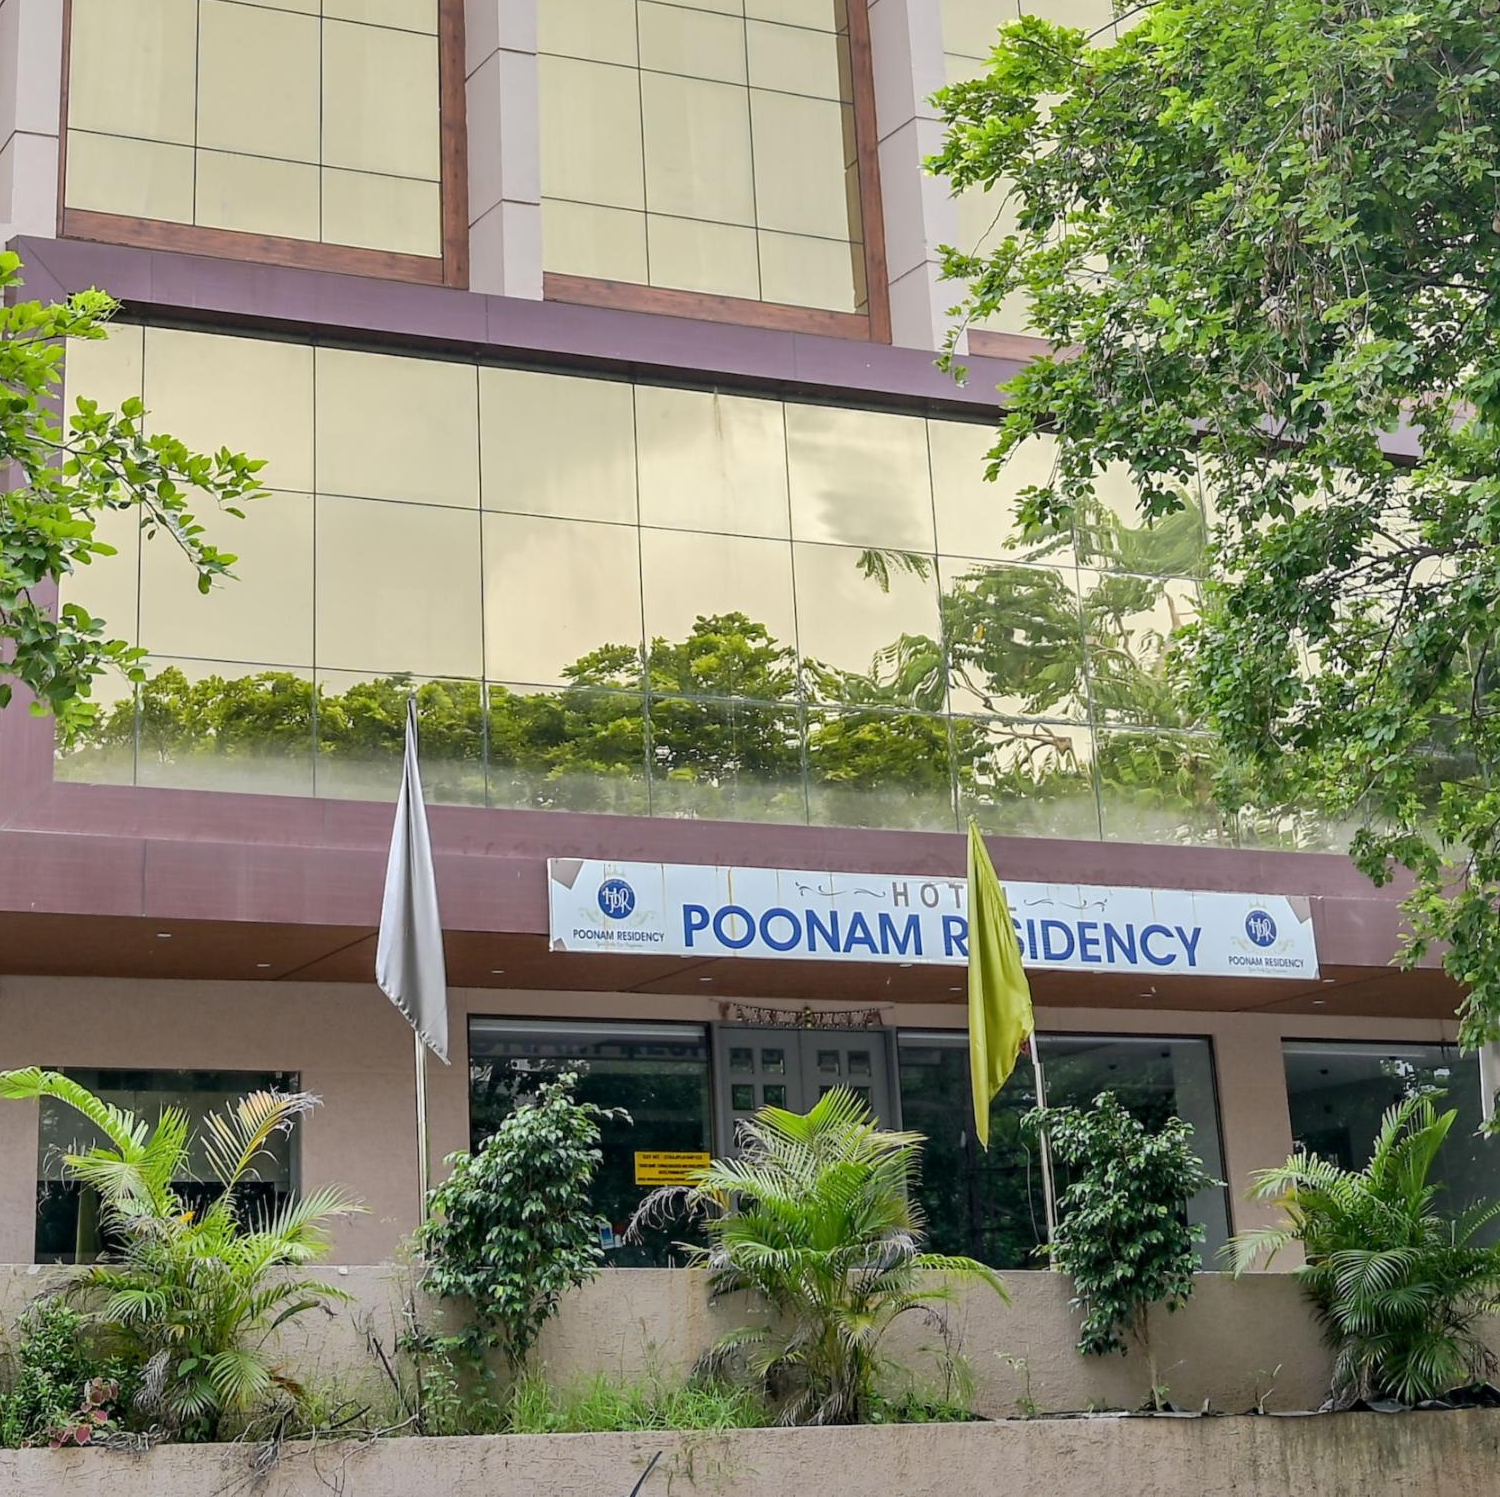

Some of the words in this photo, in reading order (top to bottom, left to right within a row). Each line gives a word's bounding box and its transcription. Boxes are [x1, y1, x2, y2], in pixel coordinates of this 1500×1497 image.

[892, 882, 1016, 911] HOTL
[573, 929, 614, 941] POONAM
[617, 931, 664, 943] RESIDENCY
[683, 904, 922, 956] POONAM
[942, 915, 1201, 966] RSIDENCY
[1228, 956, 1262, 966] POONAM
[1265, 958, 1304, 968] RESIDENCY
